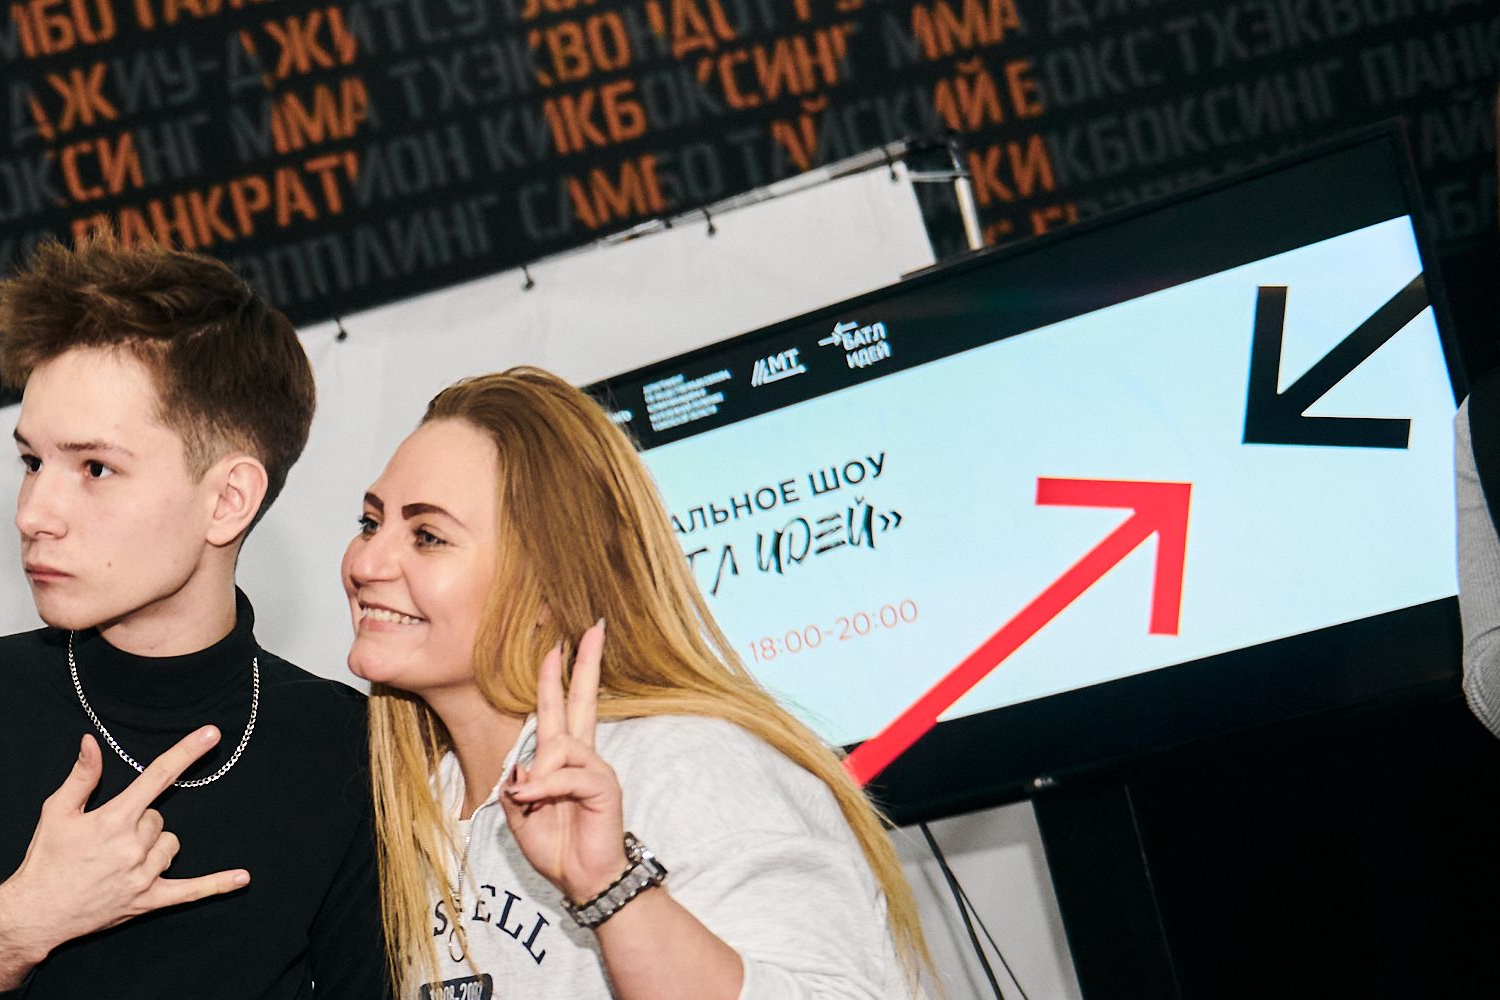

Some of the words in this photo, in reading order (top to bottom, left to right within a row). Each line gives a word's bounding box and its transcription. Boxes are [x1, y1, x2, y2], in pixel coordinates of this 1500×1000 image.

[227, 76, 380, 162] ММА
[481, 20, 862, 173] КИКБОКСИНГ
[518, 142, 724, 241] САМБО
[1004, 27, 1164, 119] БОКС
[966, 58, 1342, 206] КИКБОКСИНГ
[809, 452, 885, 496] ШОУ
[750, 598, 918, 663] 18:00-20:00
